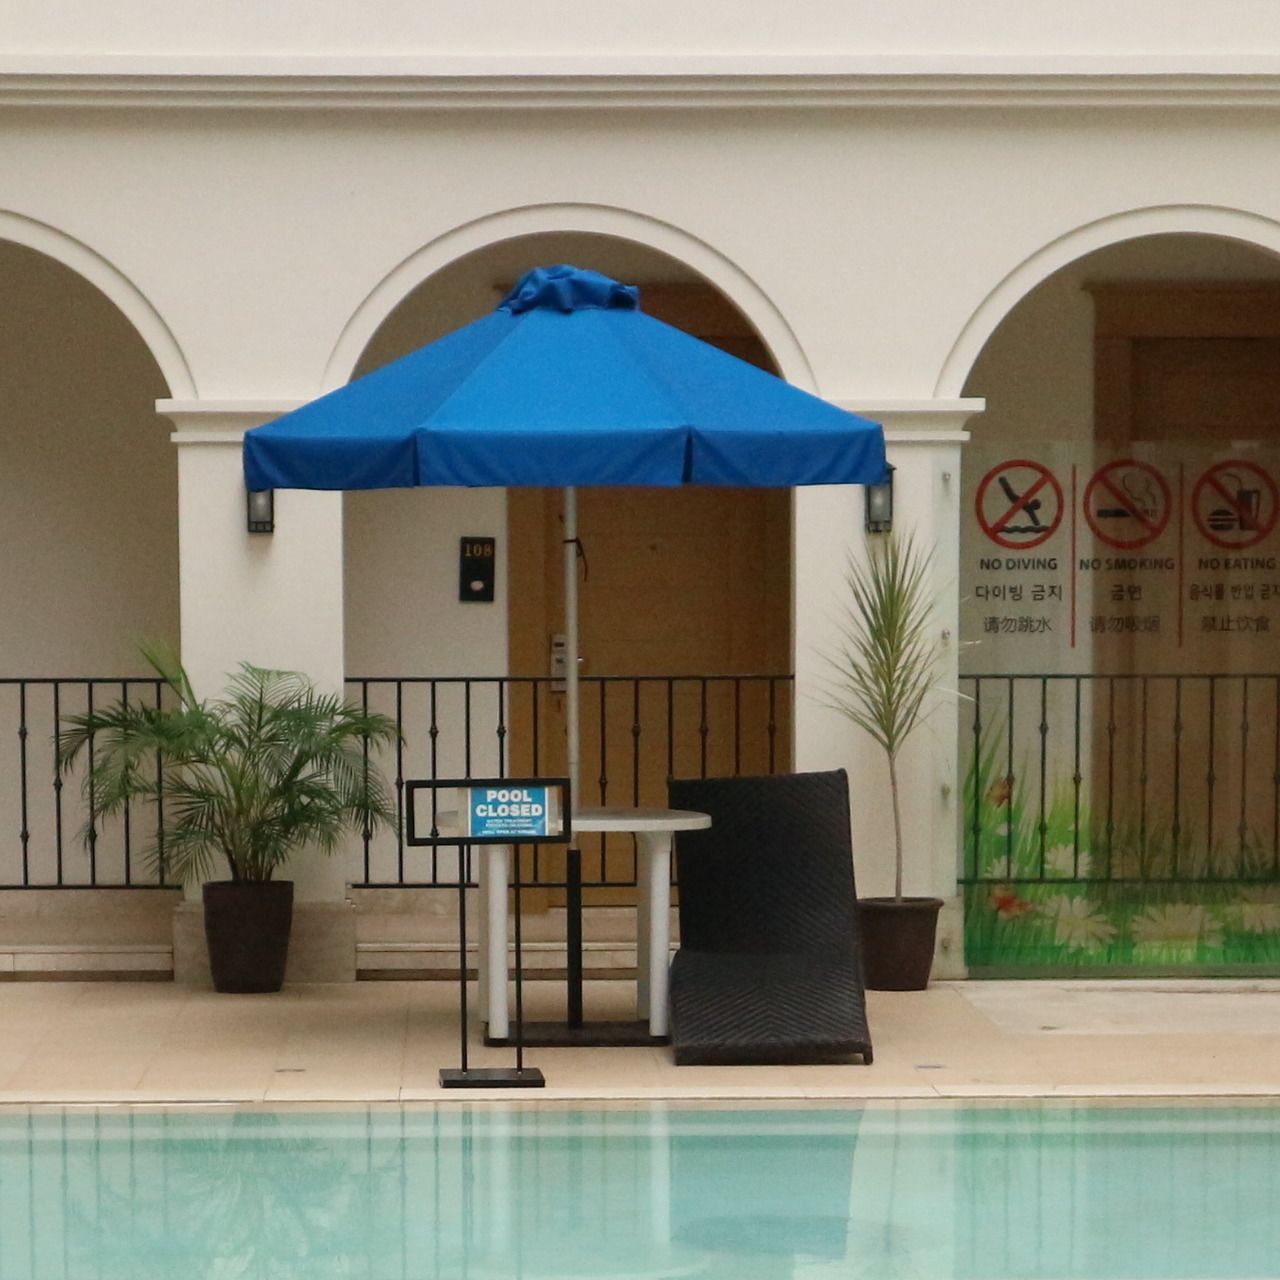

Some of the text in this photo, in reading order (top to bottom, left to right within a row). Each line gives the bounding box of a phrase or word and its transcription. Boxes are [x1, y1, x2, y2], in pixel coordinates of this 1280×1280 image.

[980, 558, 1058, 570] NO DIVING
[1079, 558, 1175, 570] NO SMOKING
[1198, 558, 1276, 570] NO EATING
[975, 584, 1062, 601] 다이빙 금지
[1111, 584, 1142, 601] 금연
[984, 616, 1052, 633] 请勿跳水
[486, 790, 532, 803] POOL
[475, 804, 543, 817] CLOSED
